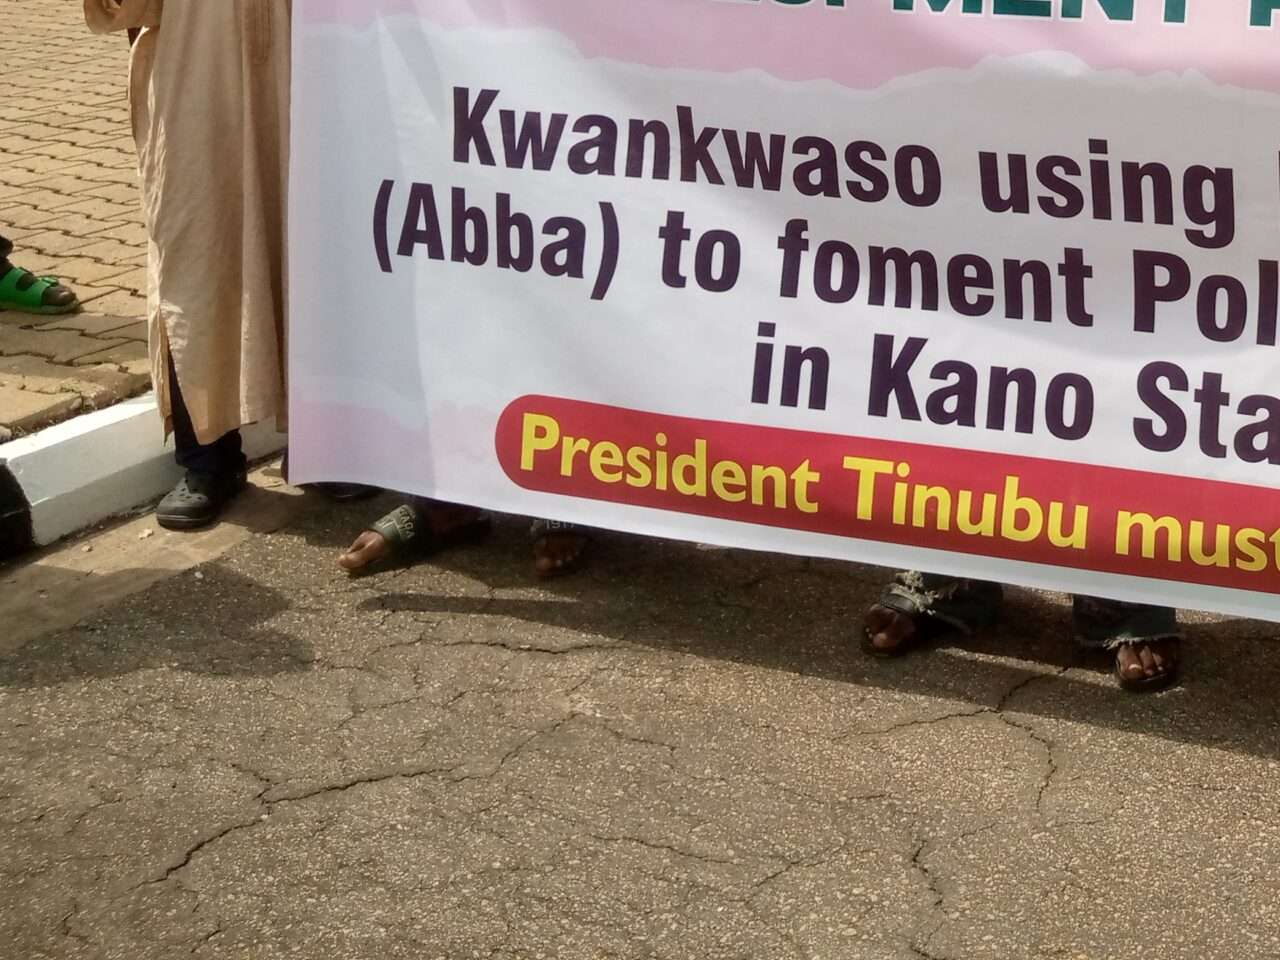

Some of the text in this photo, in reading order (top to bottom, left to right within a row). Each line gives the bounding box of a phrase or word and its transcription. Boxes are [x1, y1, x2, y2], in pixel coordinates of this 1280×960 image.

[454, 87, 941, 207] Kwankwaso
[979, 139, 1235, 249] using
[373, 180, 619, 300] (Abba)
[659, 211, 740, 292] to
[778, 219, 1093, 327] foment
[752, 322, 829, 410] in
[868, 334, 1093, 440] Kano
[522, 413, 820, 512] President
[844, 457, 1088, 548] Tinubu
